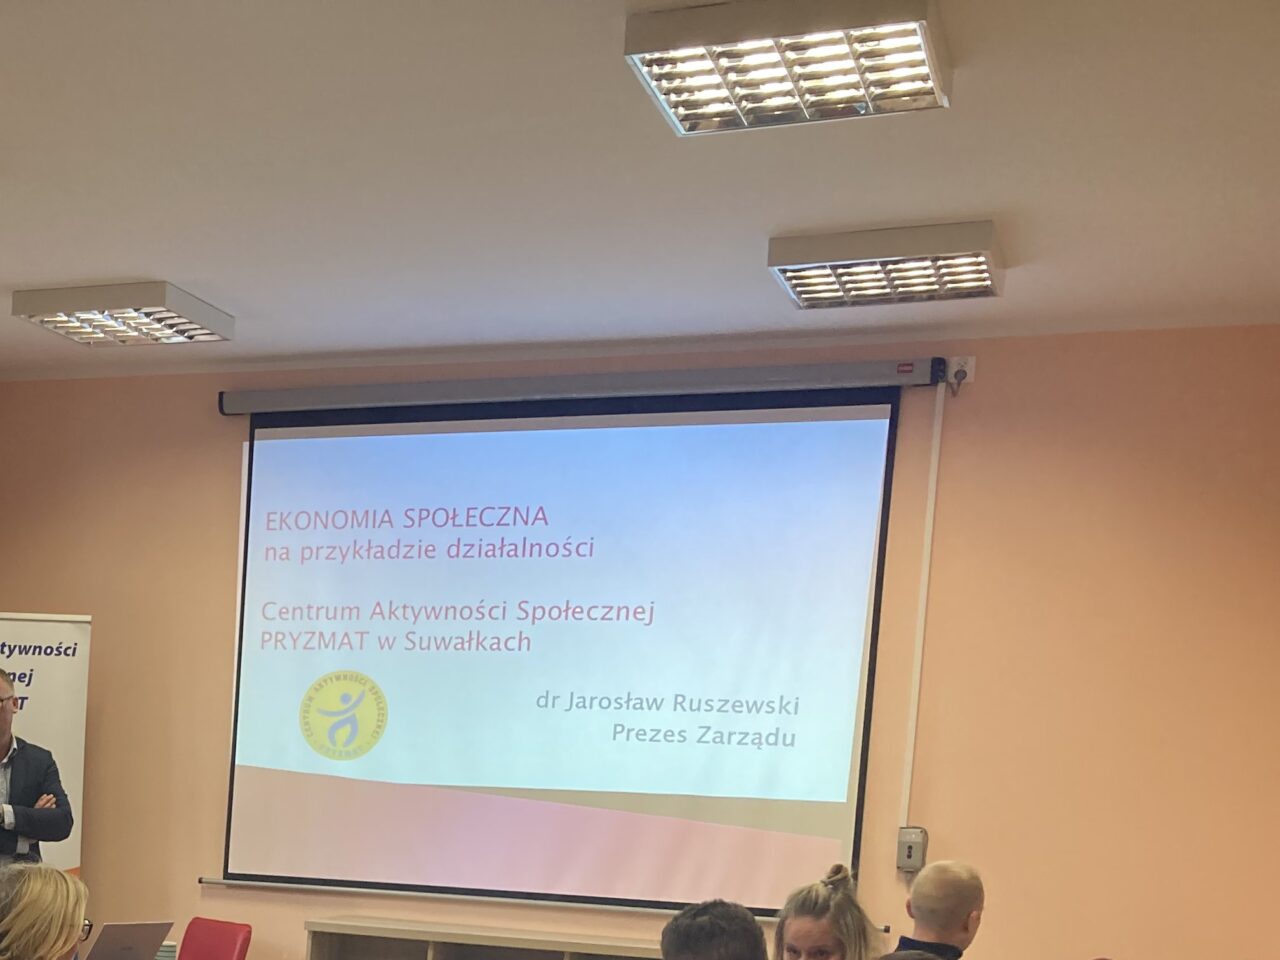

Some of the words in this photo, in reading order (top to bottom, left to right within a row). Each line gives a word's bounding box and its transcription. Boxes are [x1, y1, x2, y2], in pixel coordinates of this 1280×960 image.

[266, 509, 394, 531] EKONOMIA
[403, 505, 549, 528] SPOŁECZNA
[264, 546, 290, 561] na
[300, 538, 437, 565] przykładzie
[447, 535, 595, 559] działalności
[261, 601, 360, 621] Centrum
[369, 599, 507, 625] Aktywności
[516, 599, 655, 626] Społecznej
[260, 631, 370, 650] PRYZMAT
[377, 636, 397, 650] w
[404, 630, 531, 652] Suwałkach
[535, 690, 561, 709] dr
[564, 691, 665, 712] Jarosław
[673, 693, 800, 716] Ruszewski
[612, 723, 687, 743] Prezes
[696, 725, 796, 750] Zarządu
